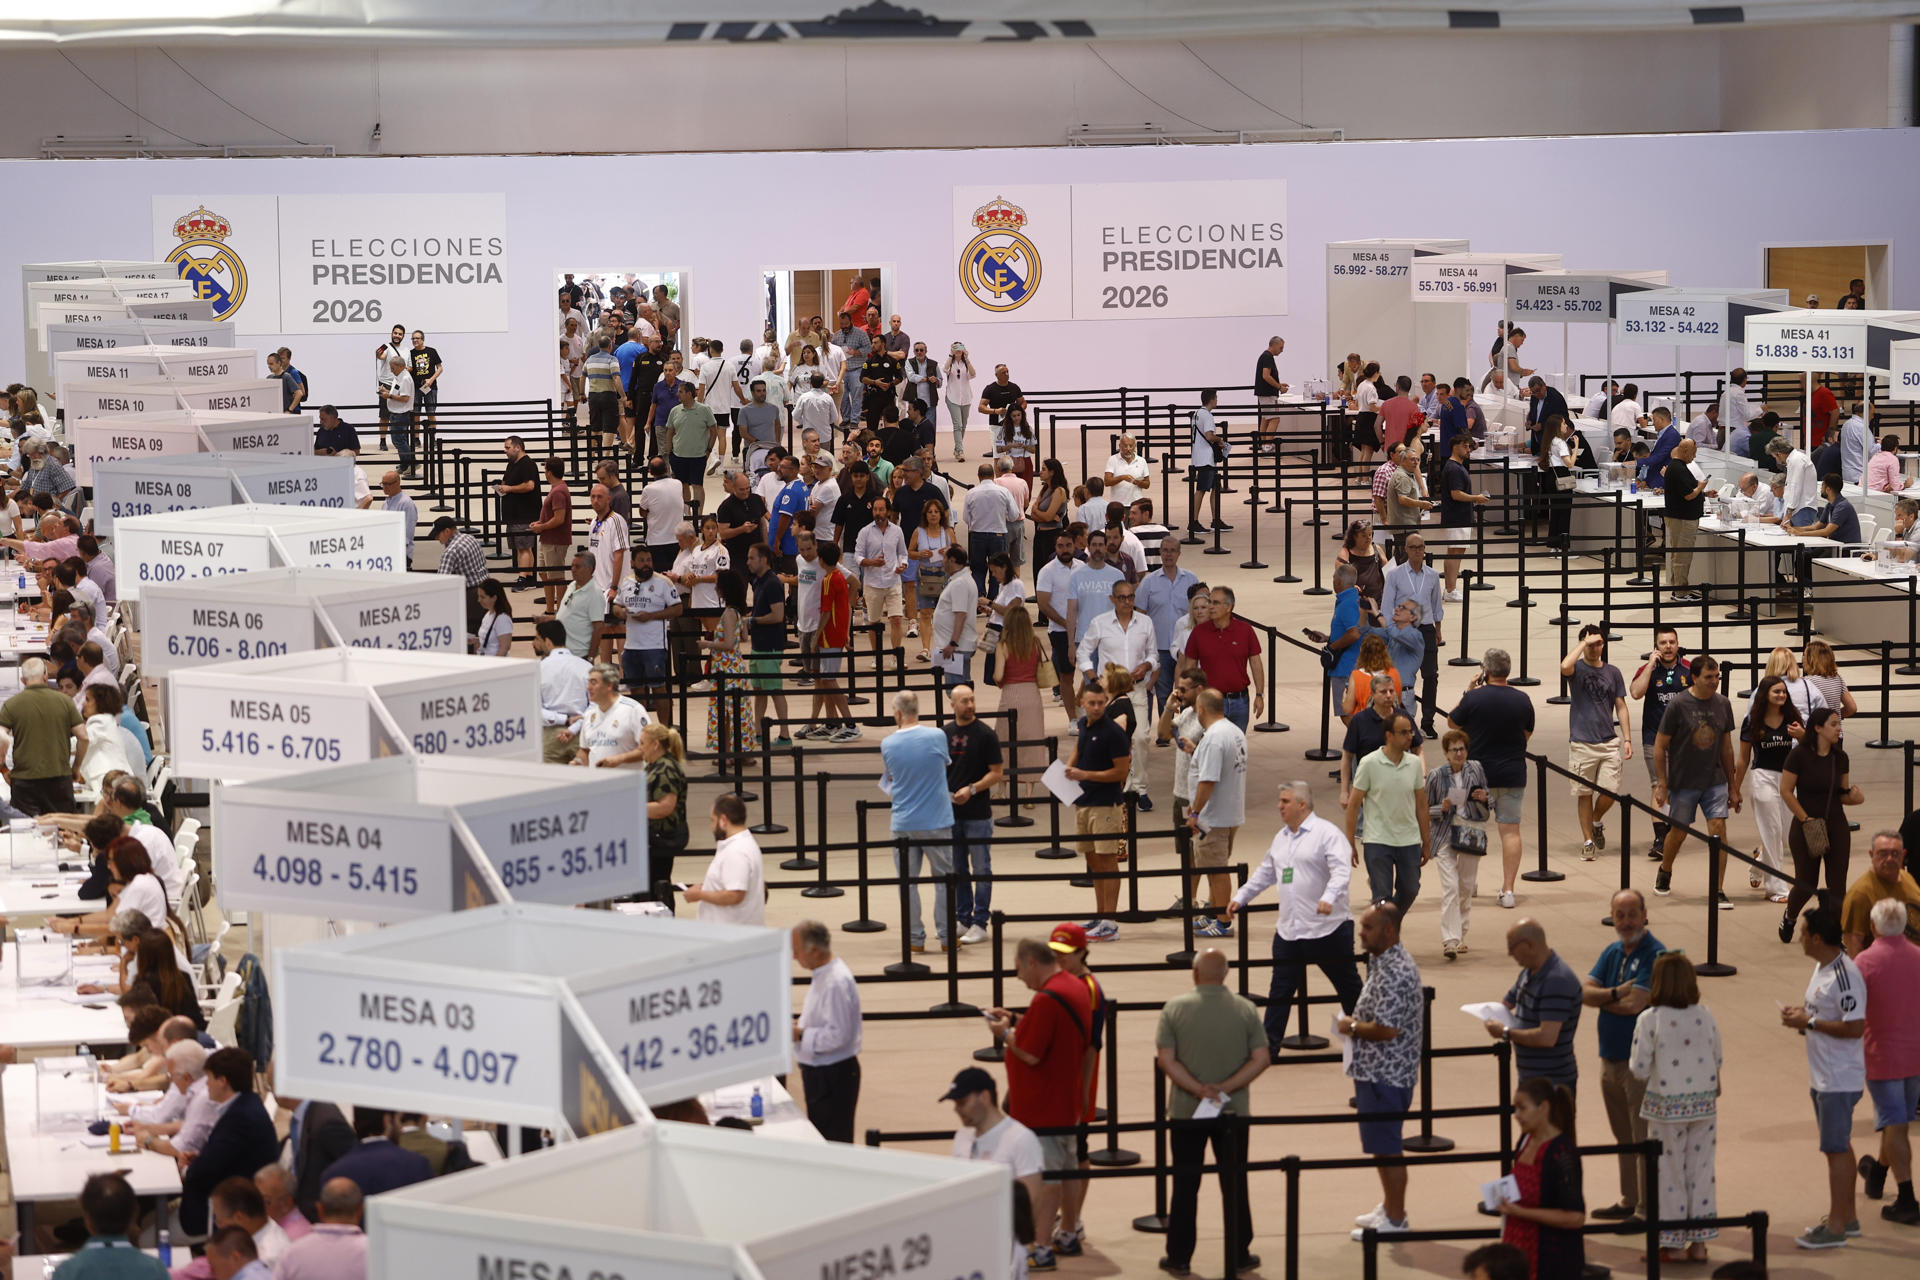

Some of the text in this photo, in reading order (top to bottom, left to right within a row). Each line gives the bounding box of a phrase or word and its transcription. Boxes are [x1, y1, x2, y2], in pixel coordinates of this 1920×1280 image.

[1102, 222, 1284, 245] ELECCIONES
[312, 237, 503, 257] ELECCIONES
[1102, 248, 1284, 272] PRESIDENCIA
[1352, 253, 1390, 262] MESA 45
[312, 263, 503, 285] PRESIDENCIA
[1334, 265, 1366, 275] 56.992
[1376, 266, 1408, 276] 58.277
[1439, 268, 1478, 277] MESA 44
[1102, 285, 1168, 308] 2026
[1419, 281, 1454, 292] 55.703
[1463, 282, 1497, 293] 56.991
[1538, 286, 1580, 295] MESA 43
[312, 300, 382, 323] 2026
[1516, 300, 1554, 311] 54.423
[1564, 300, 1602, 312] 55.702
[1649, 306, 1695, 316] MESA 42
[65, 314, 89, 323] MESA
[1626, 320, 1666, 333] 53.132
[1678, 322, 1719, 334] 54.422
[77, 338, 116, 349] MESA 12
[198, 336, 208, 347] 19
[1781, 329, 1830, 340] MESA 41
[1756, 344, 1798, 358] 51.838
[1811, 345, 1854, 359] 53.131
[87, 366, 128, 379] MESA 11
[188, 365, 228, 376] MESA 20
[98, 398, 144, 412] MESA 10
[208, 396, 251, 410] MESA 21
[112, 437, 163, 451] MESA 09
[233, 434, 279, 451] MESA 22
[136, 481, 192, 497] MESA 08
[268, 478, 318, 495] MESA 23
[112, 501, 152, 518] 9.318
[162, 539, 224, 558] MESA 07
[310, 536, 364, 555] MESA 24
[140, 562, 185, 582] 8.002
[193, 609, 263, 630] MESA 06
[360, 603, 421, 627] MESA 25
[168, 635, 219, 658] 6.706
[398, 625, 452, 650] 32.579
[231, 700, 310, 724] MESA 05
[421, 693, 490, 721] MESA 26
[465, 716, 526, 748] 33.854
[202, 729, 259, 754] 5.416
[282, 736, 341, 761] 6.705
[287, 821, 382, 851] MESA 04
[510, 810, 589, 845] MESA 27
[561, 838, 627, 876] 35.141
[253, 854, 322, 886] 4.098
[348, 862, 418, 895] 5.415
[629, 979, 722, 1024] MESA 28
[360, 994, 475, 1031] MESA 03
[689, 1012, 770, 1060] 36.420
[318, 1032, 400, 1072] 2.780
[434, 1047, 518, 1086] 4.097
[902, 1233, 932, 1272] 29
